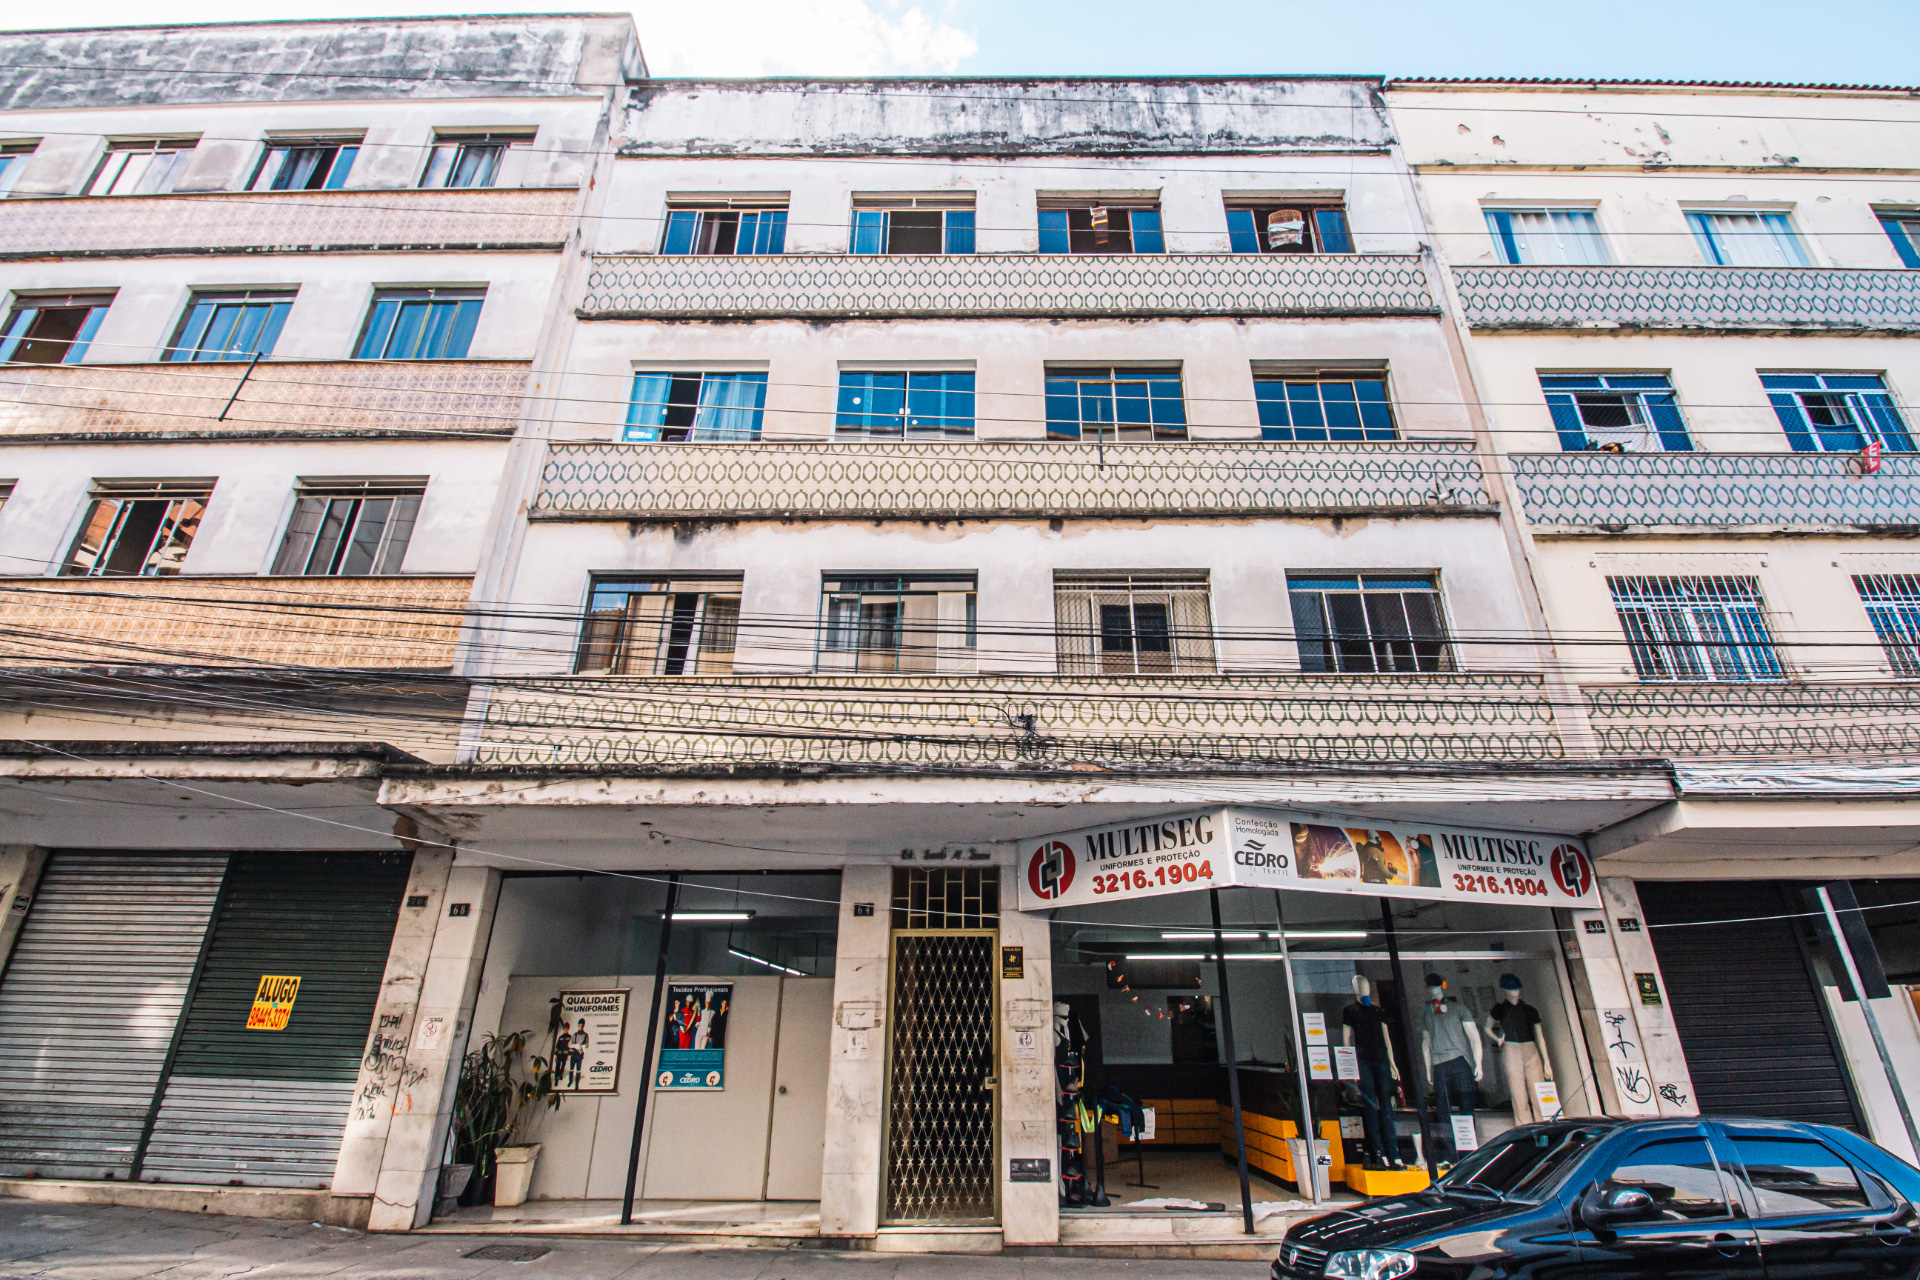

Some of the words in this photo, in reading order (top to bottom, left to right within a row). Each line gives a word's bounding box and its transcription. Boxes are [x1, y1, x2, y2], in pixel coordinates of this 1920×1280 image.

[1235, 817, 1278, 829] Confecção
[1085, 815, 1214, 862] MULTISEG
[1235, 826, 1279, 837] Homologada
[1440, 833, 1544, 866] MULTISEG
[1100, 858, 1144, 872] UNIFORMES
[1155, 849, 1201, 864] PROTEÇÃO
[1234, 850, 1289, 869] CEDRO
[1092, 859, 1214, 895] 3216.1904
[1458, 863, 1495, 873] UNIFORMES
[1503, 867, 1536, 877] PROTEÇÃO
[1452, 873, 1549, 897] 3216.1904
[453, 904, 466, 915] 68
[1588, 921, 1602, 932] 60
[1622, 920, 1636, 931] 56
[257, 977, 298, 1003] ALUGO
[566, 996, 620, 1005] QUALIDADE
[574, 1004, 620, 1012] UNIFORMES
